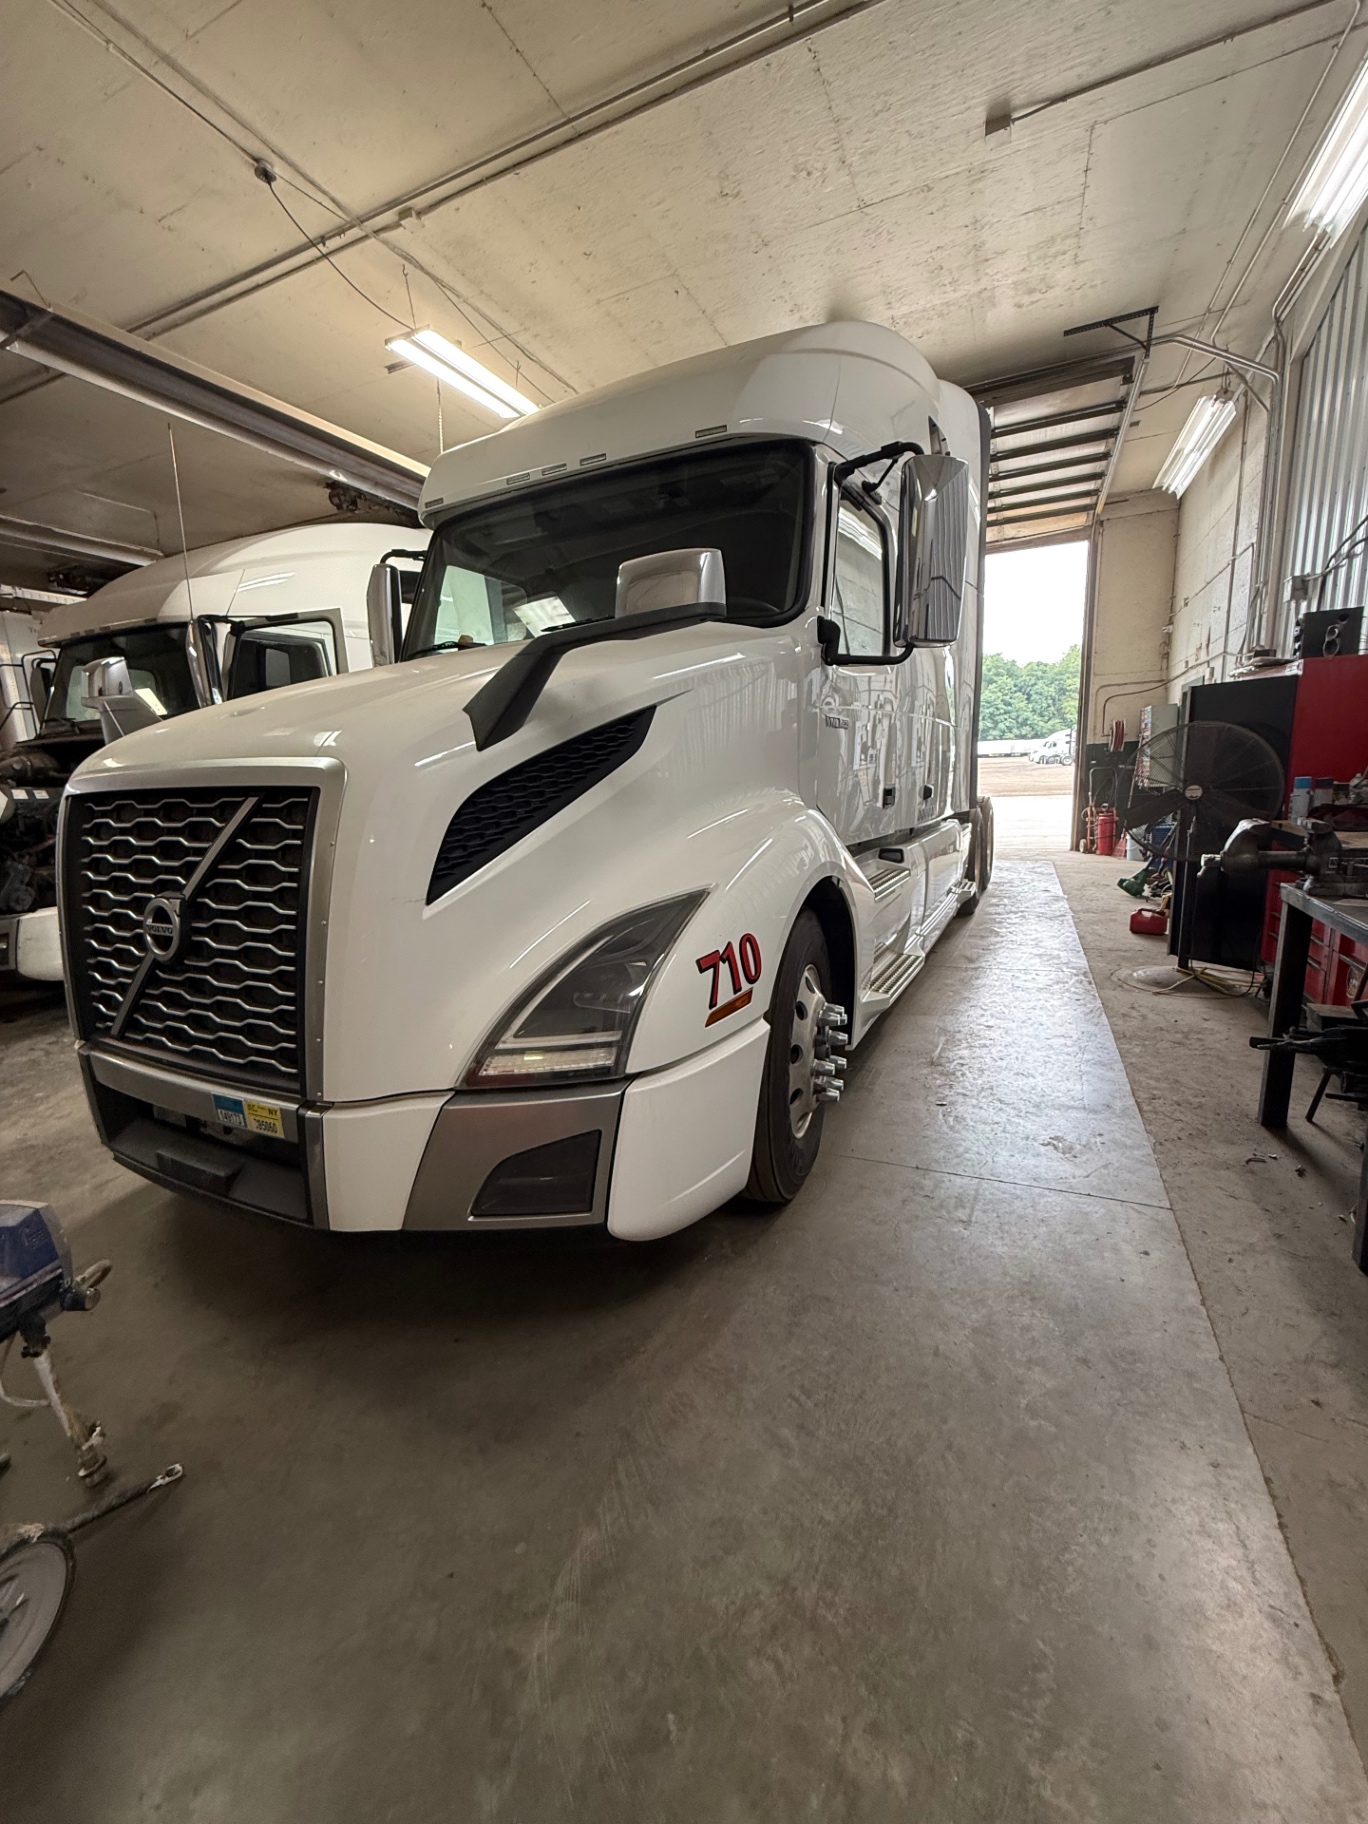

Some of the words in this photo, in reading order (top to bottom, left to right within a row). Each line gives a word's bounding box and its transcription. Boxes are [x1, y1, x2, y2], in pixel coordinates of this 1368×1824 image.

[146, 925, 173, 935] VOLVO
[695, 932, 762, 1010] 710
[268, 1107, 278, 1116] NY
